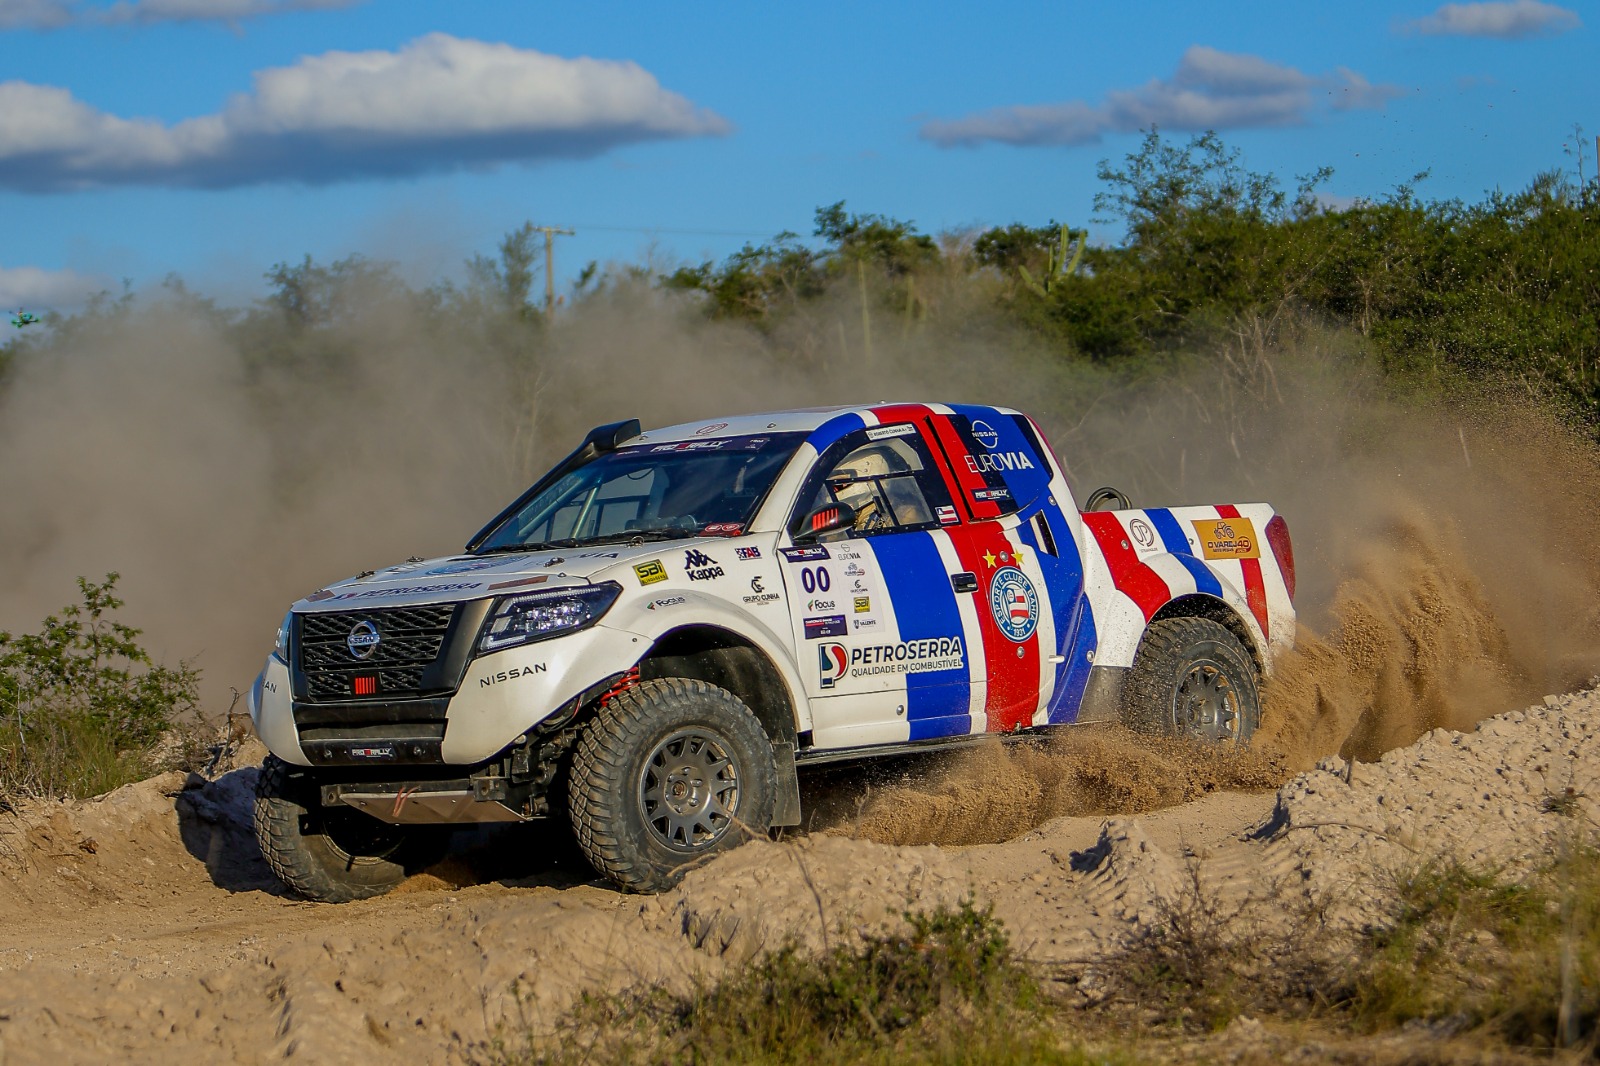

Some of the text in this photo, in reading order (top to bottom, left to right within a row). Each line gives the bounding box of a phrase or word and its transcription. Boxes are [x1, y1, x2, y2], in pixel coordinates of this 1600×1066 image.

[964, 452, 1034, 473] EUROVIA
[741, 547, 761, 558] FAB
[686, 565, 725, 581] Kappa
[801, 566, 830, 593] 00
[743, 593, 780, 602] GRUPO CUNHA
[993, 573, 1037, 625] ESPORTE CLUBE BAHIA
[1014, 628, 1026, 637] 1931
[851, 638, 962, 665] PETROSERRA
[480, 663, 547, 688] NISSAN
[851, 658, 962, 677] QUALIDADE EM COMBUSTÍVEL
